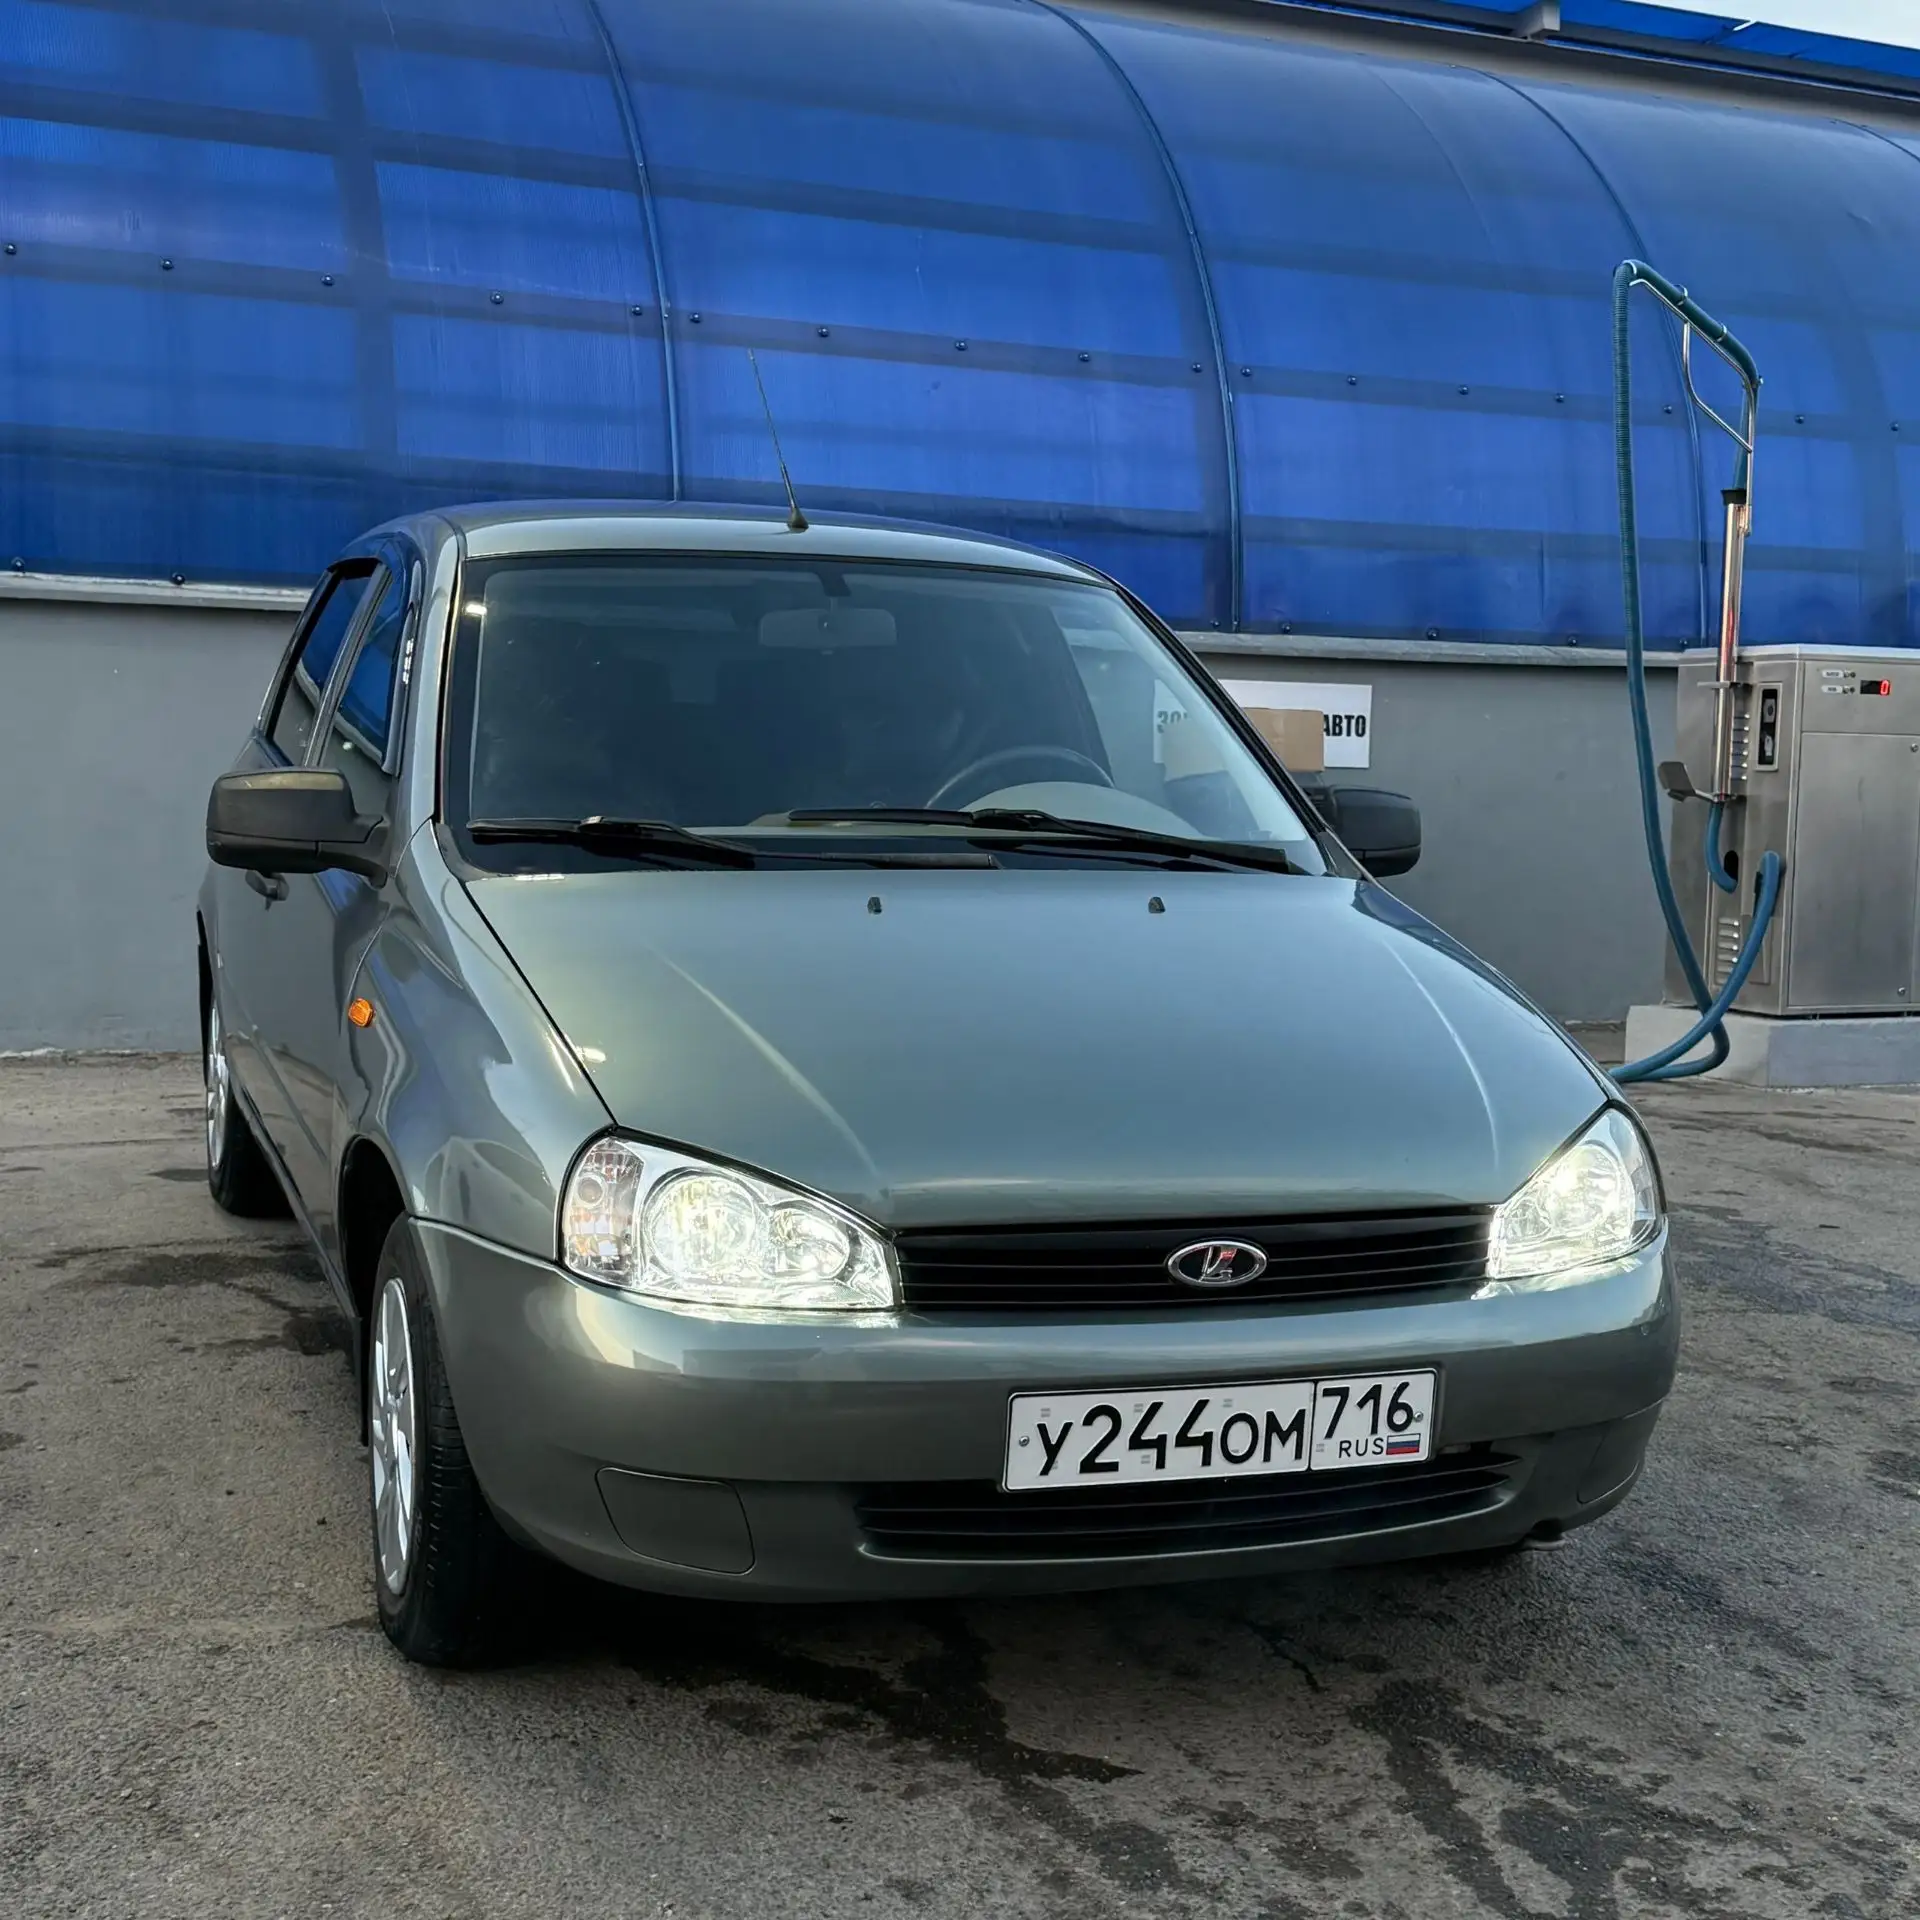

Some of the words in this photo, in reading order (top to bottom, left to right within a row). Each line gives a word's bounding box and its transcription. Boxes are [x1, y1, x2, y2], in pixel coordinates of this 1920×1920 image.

[1881, 680, 1890, 695] 0
[1323, 714, 1366, 737] АВТО
[1036, 1398, 1307, 1476] У244ОМ
[1321, 1381, 1414, 1440] 716
[1338, 1437, 1385, 1459] RUS
